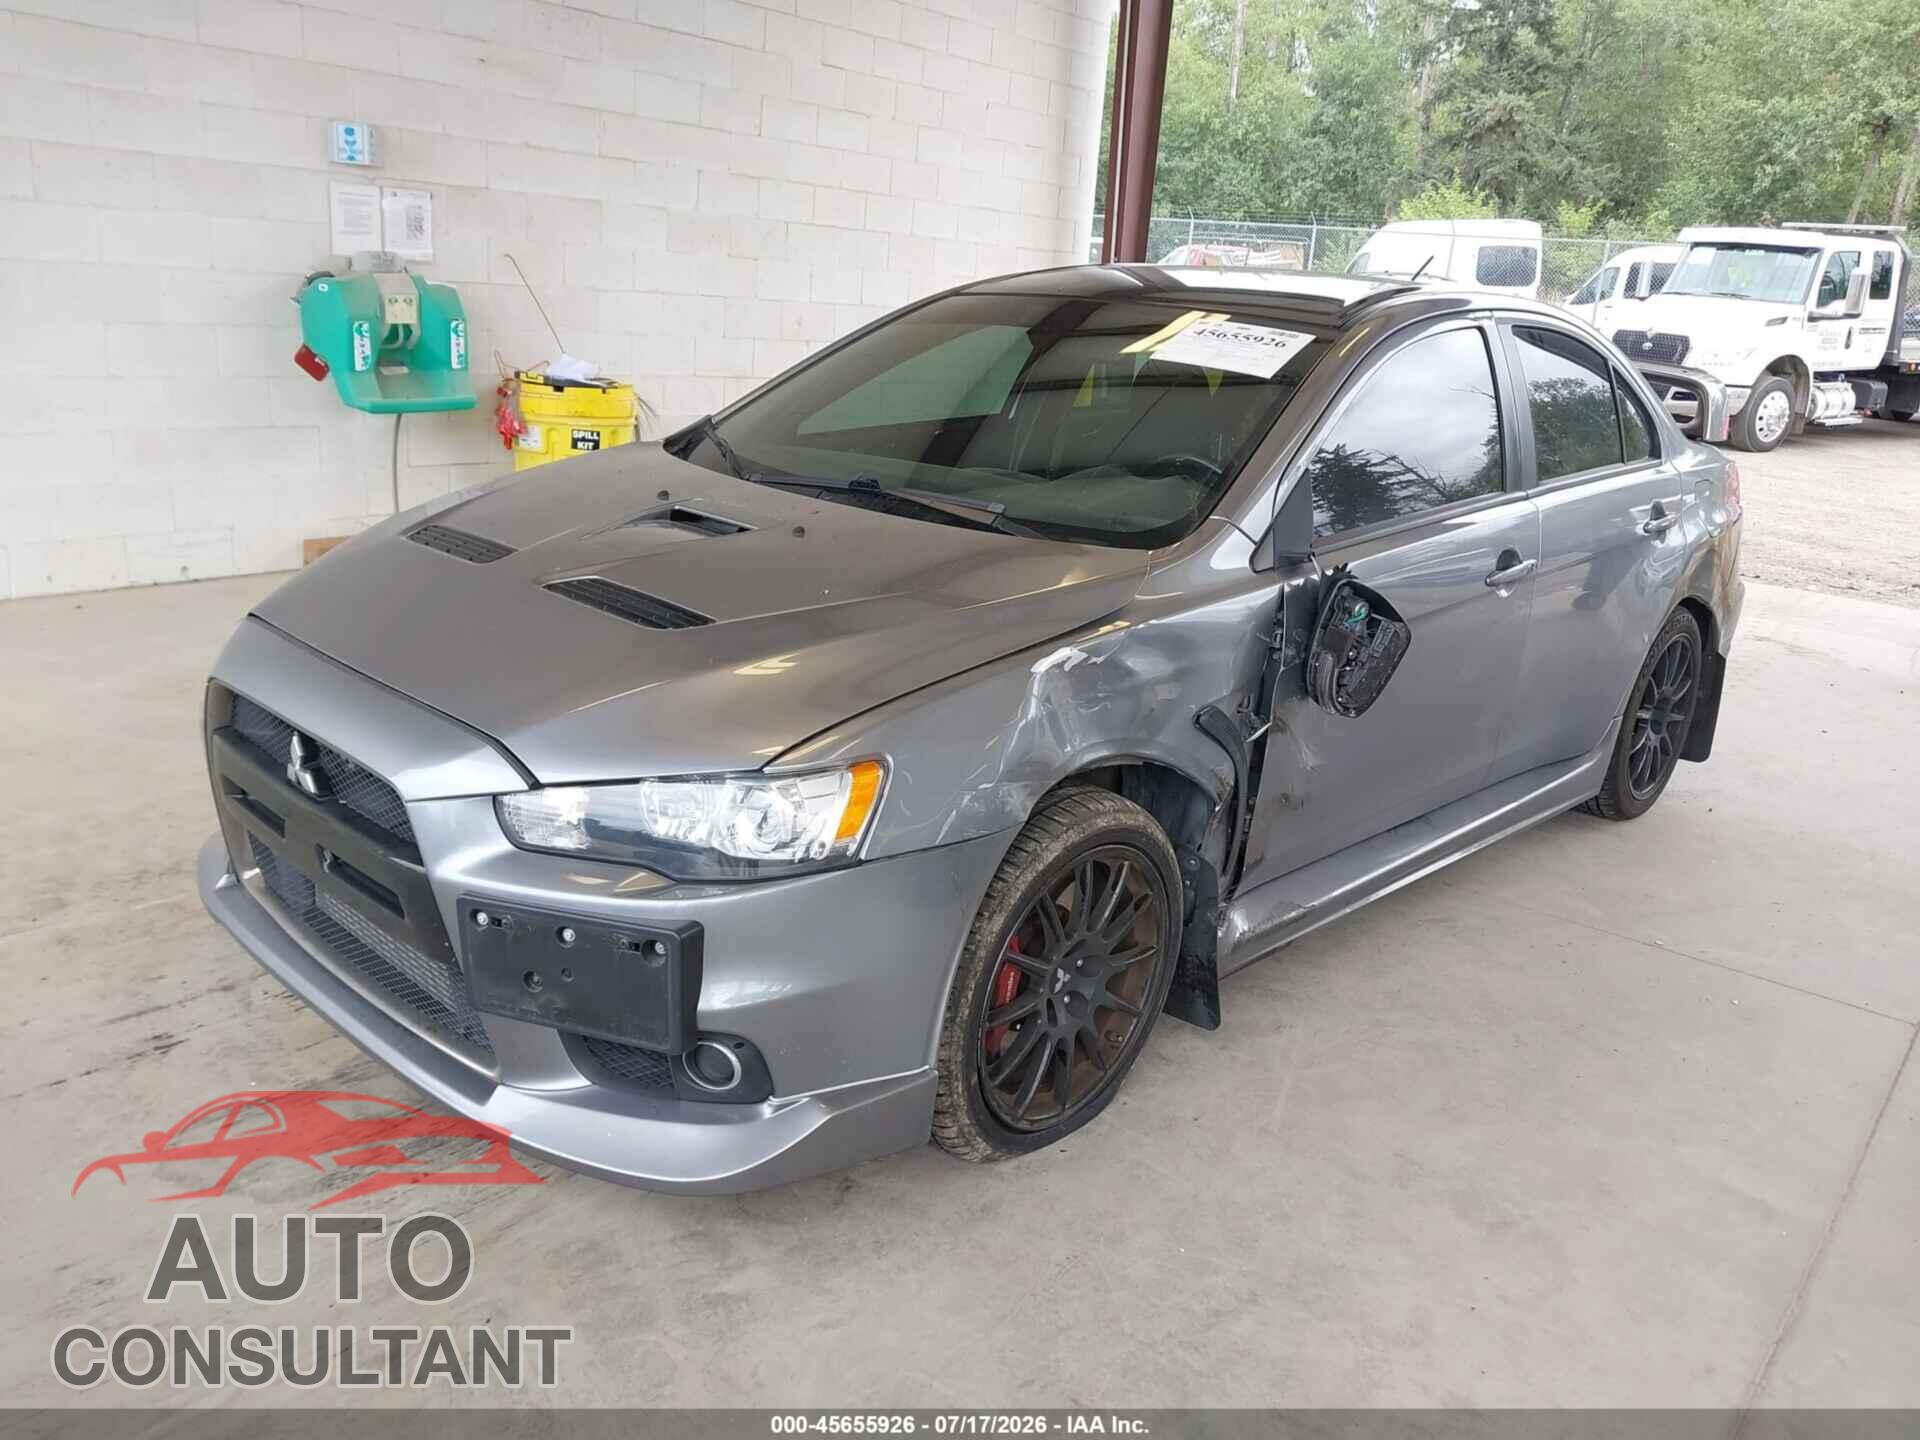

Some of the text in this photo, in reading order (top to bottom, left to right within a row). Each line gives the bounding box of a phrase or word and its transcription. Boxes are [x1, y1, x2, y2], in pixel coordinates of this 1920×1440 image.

[1193, 328, 1287, 347] 45655926
[572, 430, 599, 440] SPILL
[577, 442, 595, 450] KIT
